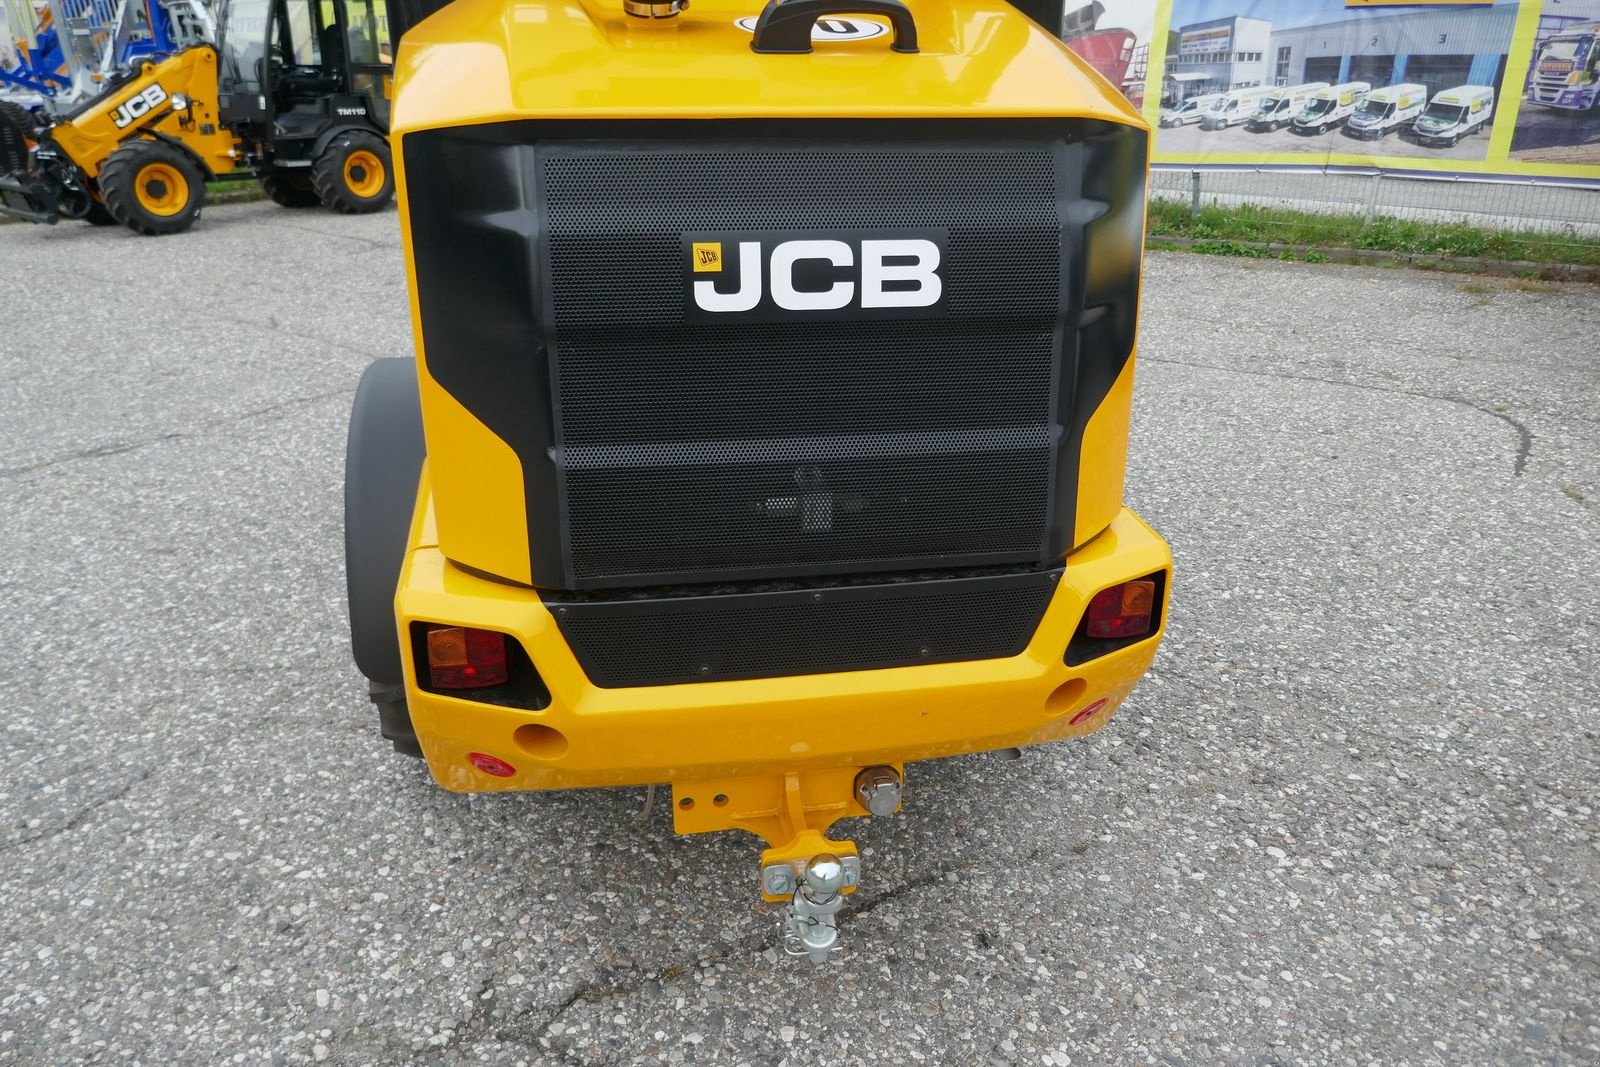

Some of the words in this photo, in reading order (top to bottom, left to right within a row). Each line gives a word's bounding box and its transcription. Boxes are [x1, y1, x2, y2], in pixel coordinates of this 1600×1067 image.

[1438, 33, 1447, 44] 3
[114, 83, 168, 128] JCB
[336, 107, 366, 116] TM110
[700, 250, 717, 264] JCB
[693, 239, 942, 312] JCB
